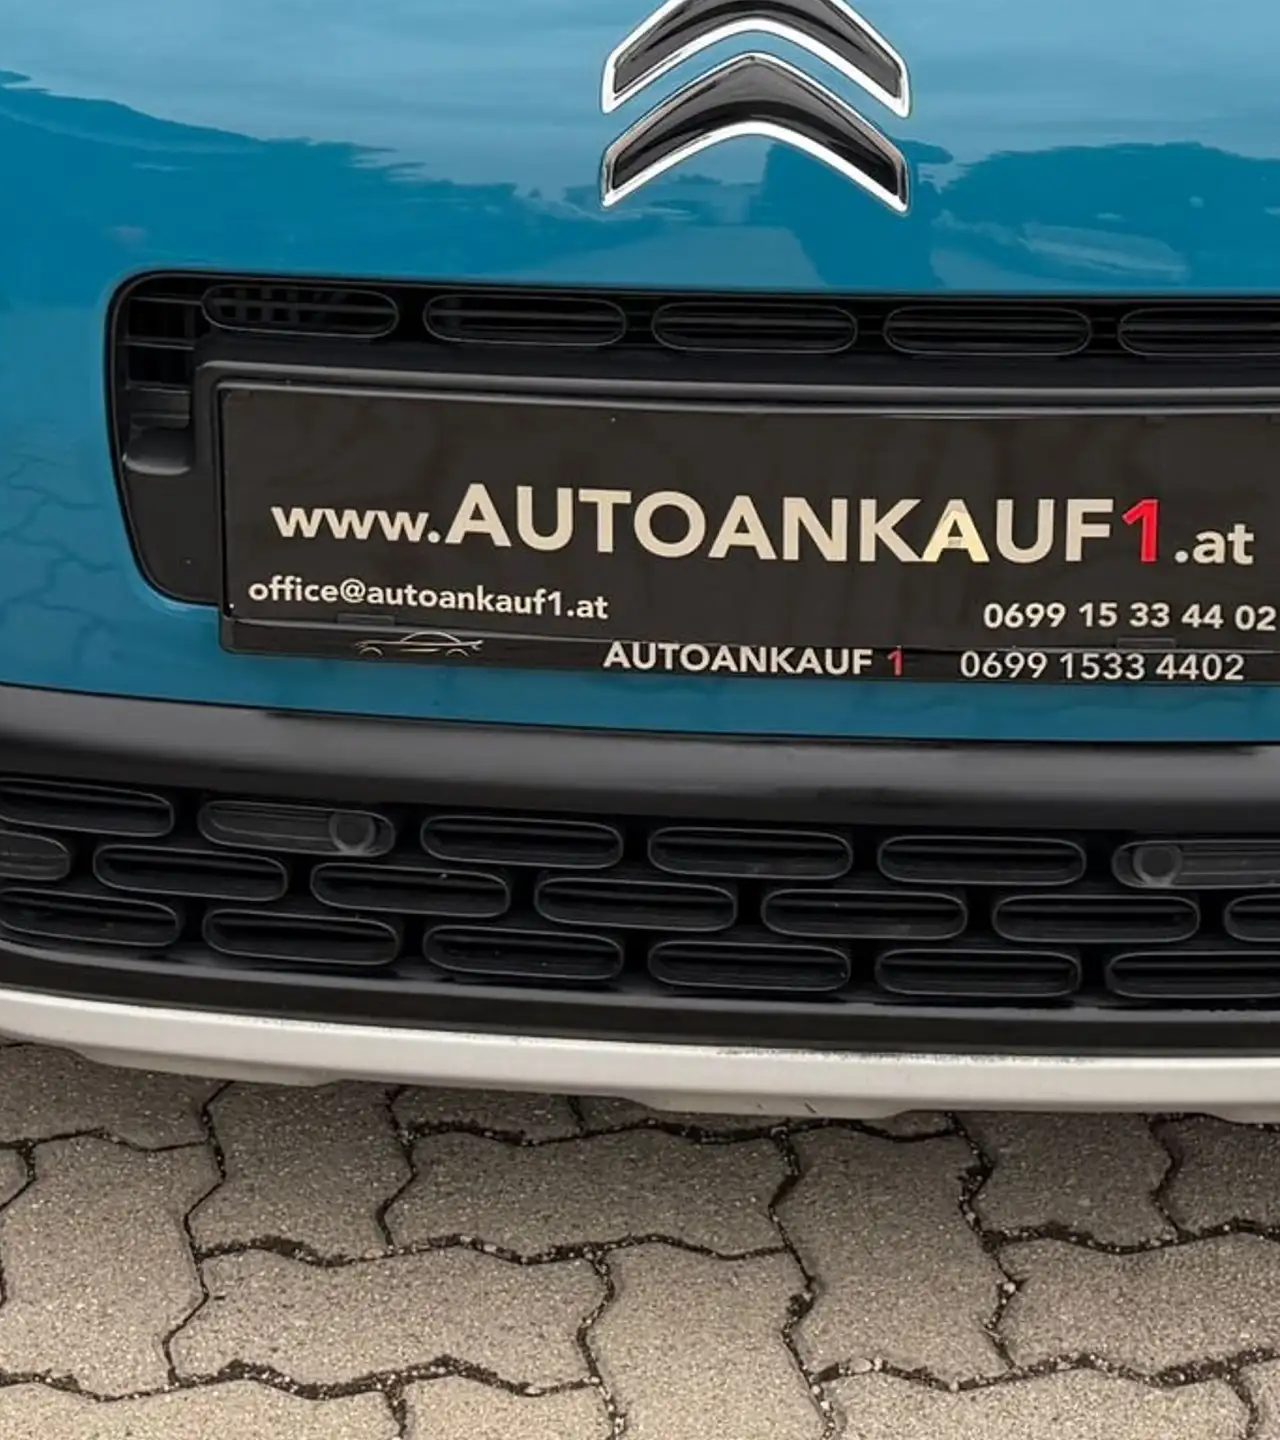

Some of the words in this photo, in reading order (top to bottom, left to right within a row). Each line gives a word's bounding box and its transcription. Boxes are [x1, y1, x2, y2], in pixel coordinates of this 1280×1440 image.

[271, 483, 1255, 565] www.AUTOANKAUF1.at
[248, 574, 609, 620] office@autoankauf1.at
[983, 602, 1066, 629] 0699
[1076, 602, 1118, 628] 15
[1129, 602, 1170, 628] 33
[1181, 603, 1224, 629] 44
[1235, 604, 1277, 631] 02
[602, 640, 873, 676] AUTOANKAUF
[887, 647, 904, 677] 1
[960, 650, 1049, 679] 0699
[1059, 652, 1145, 680] 1533
[1155, 653, 1244, 681] 4402
